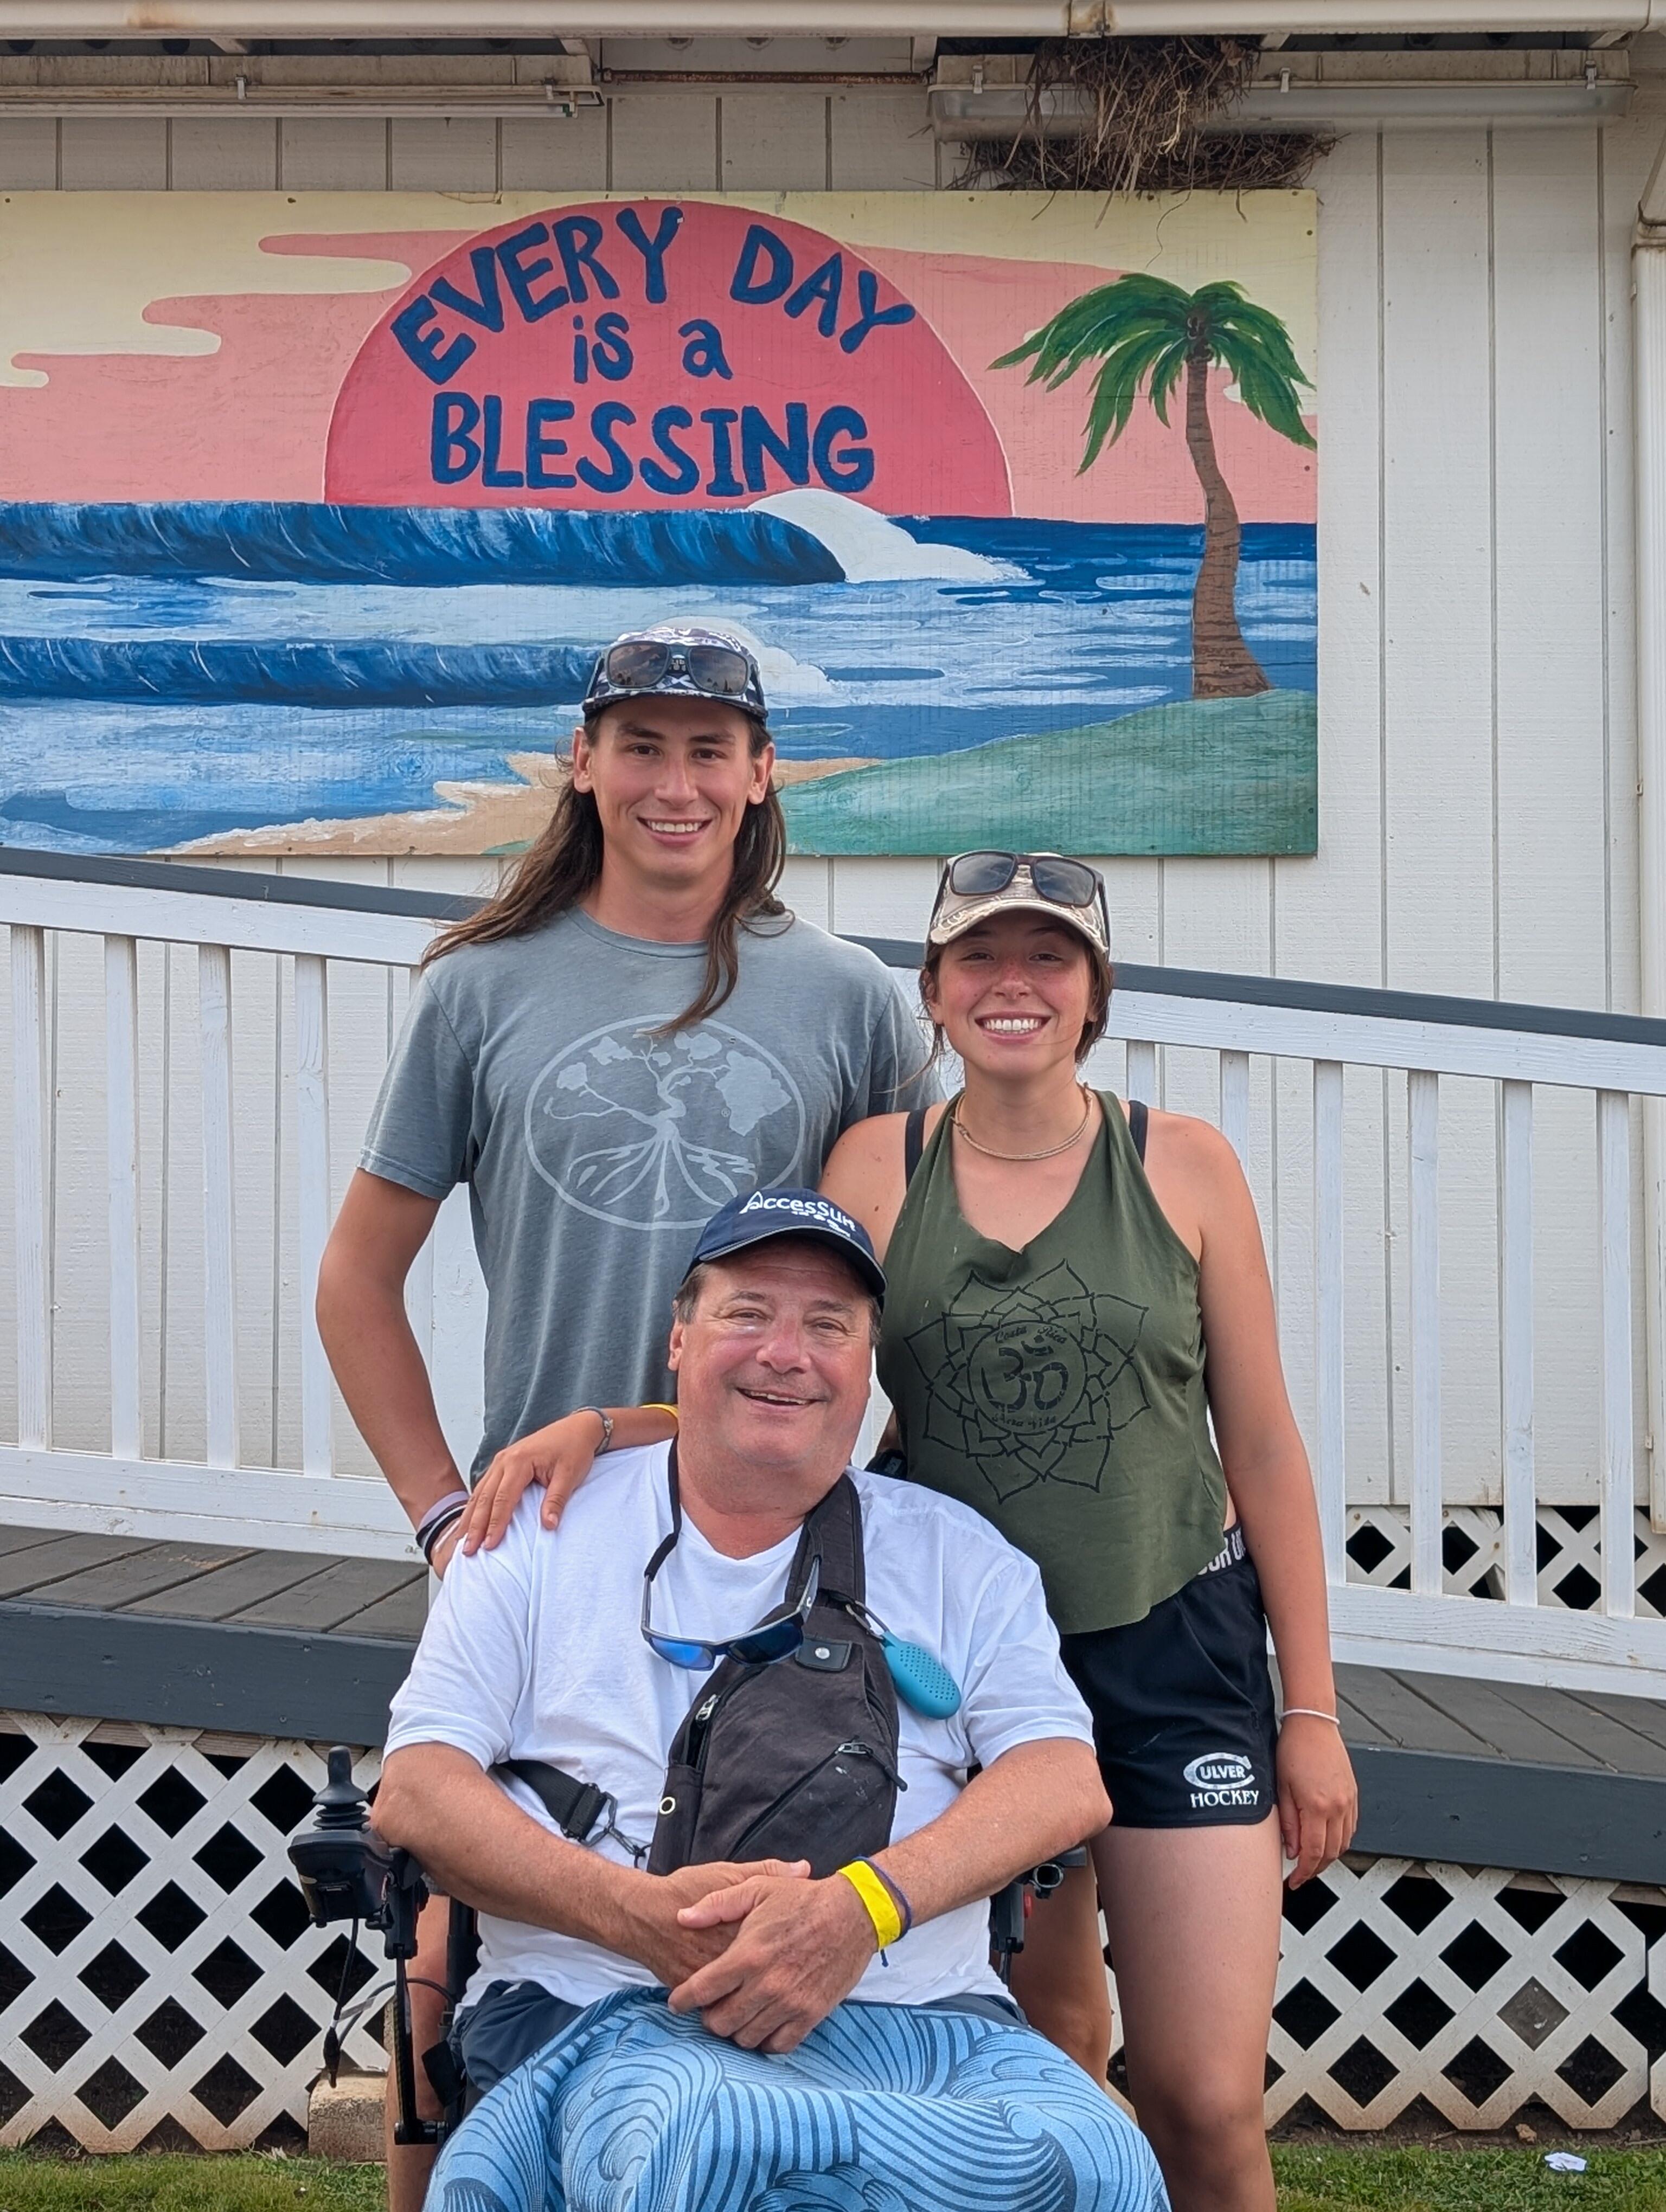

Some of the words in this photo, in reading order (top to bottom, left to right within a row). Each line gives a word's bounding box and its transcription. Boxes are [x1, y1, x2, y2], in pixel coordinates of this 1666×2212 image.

[393, 207, 681, 384] EVERY
[731, 226, 915, 352] DAY
[574, 313, 632, 382] is
[680, 319, 732, 379] a
[431, 392, 874, 497] BLESSING
[1190, 1790, 1259, 1808] HOCKEY
